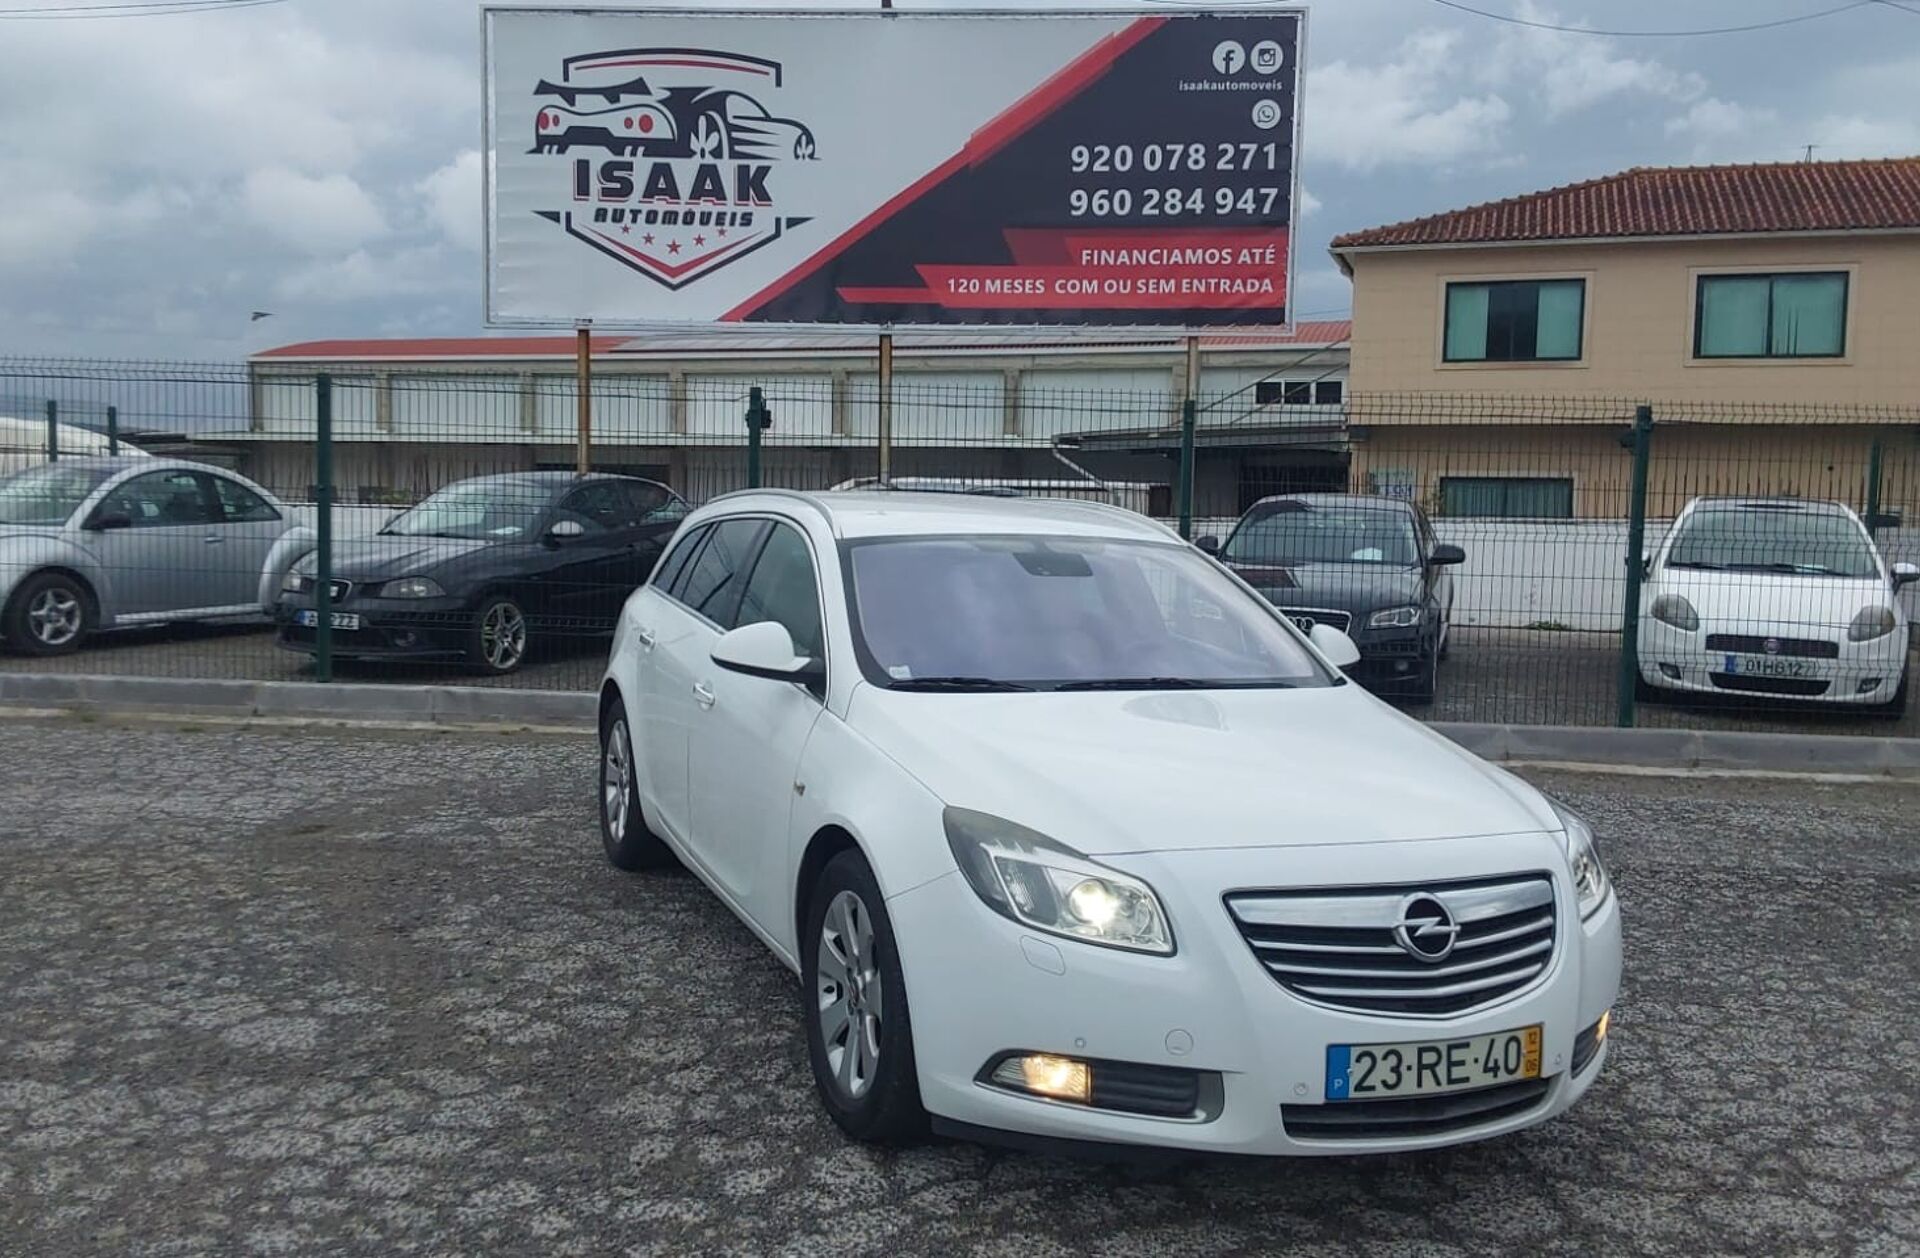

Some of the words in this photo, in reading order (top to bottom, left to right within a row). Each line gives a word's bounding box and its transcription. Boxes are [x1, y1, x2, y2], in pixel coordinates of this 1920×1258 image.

[1179, 79, 1283, 91] isaakautomoveis
[1071, 145, 1133, 172] 920
[1143, 144, 1206, 172] 078
[1216, 143, 1276, 171] 271
[573, 158, 773, 207] ISAAK
[1070, 189, 1132, 216] 960
[1141, 188, 1205, 216] 284
[1215, 188, 1279, 215] 947
[593, 207, 754, 228] AUTOMÓVEIS
[1081, 249, 1232, 266] FINANCIAMOS
[1237, 244, 1276, 265] ATÉ
[948, 279, 980, 294] 120
[984, 280, 1045, 294] MESES
[1054, 279, 1099, 294] COM
[1103, 279, 1132, 294] OU
[1136, 279, 1176, 294] SEM
[1181, 278, 1274, 294] ENTRADA
